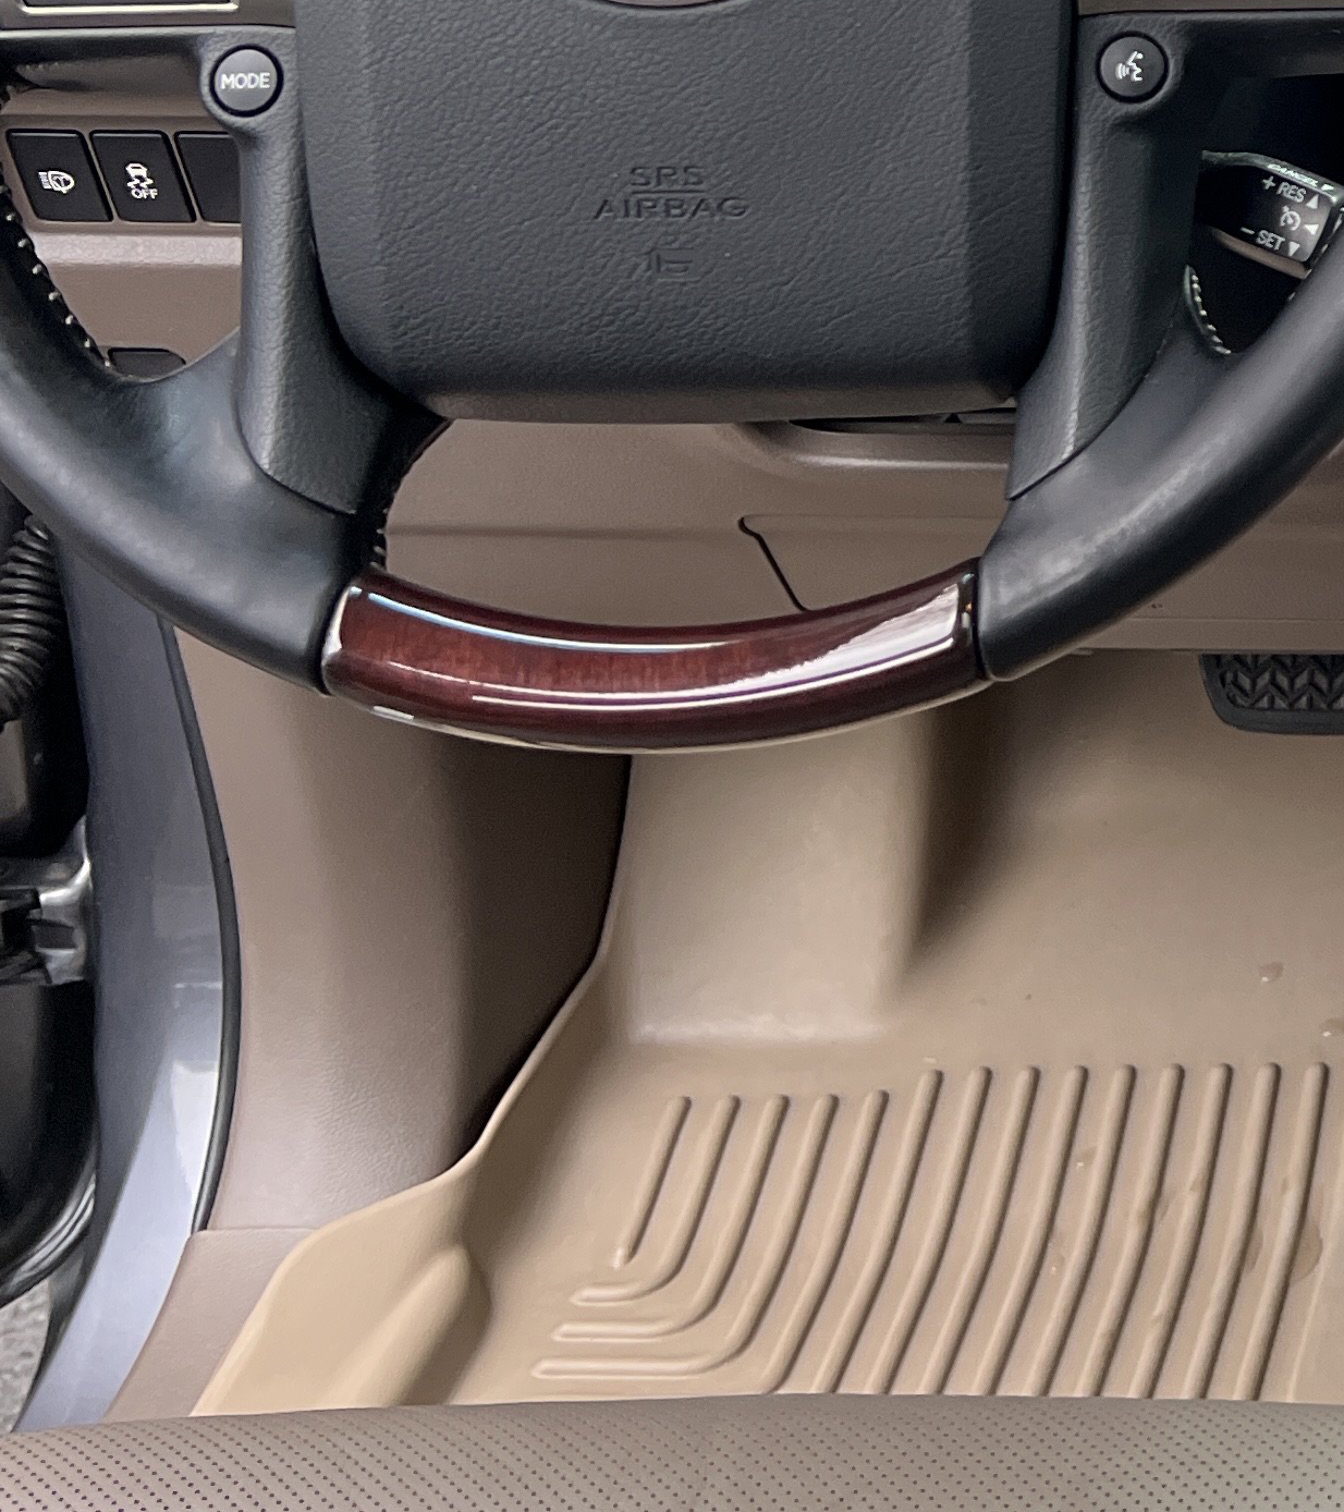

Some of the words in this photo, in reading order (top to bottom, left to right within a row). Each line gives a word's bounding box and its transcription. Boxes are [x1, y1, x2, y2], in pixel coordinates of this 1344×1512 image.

[221, 71, 271, 89] MODE
[131, 188, 158, 199] OFF
[1276, 181, 1307, 203] RES
[592, 195, 749, 220] AIRBAG
[1256, 229, 1286, 251] SET
